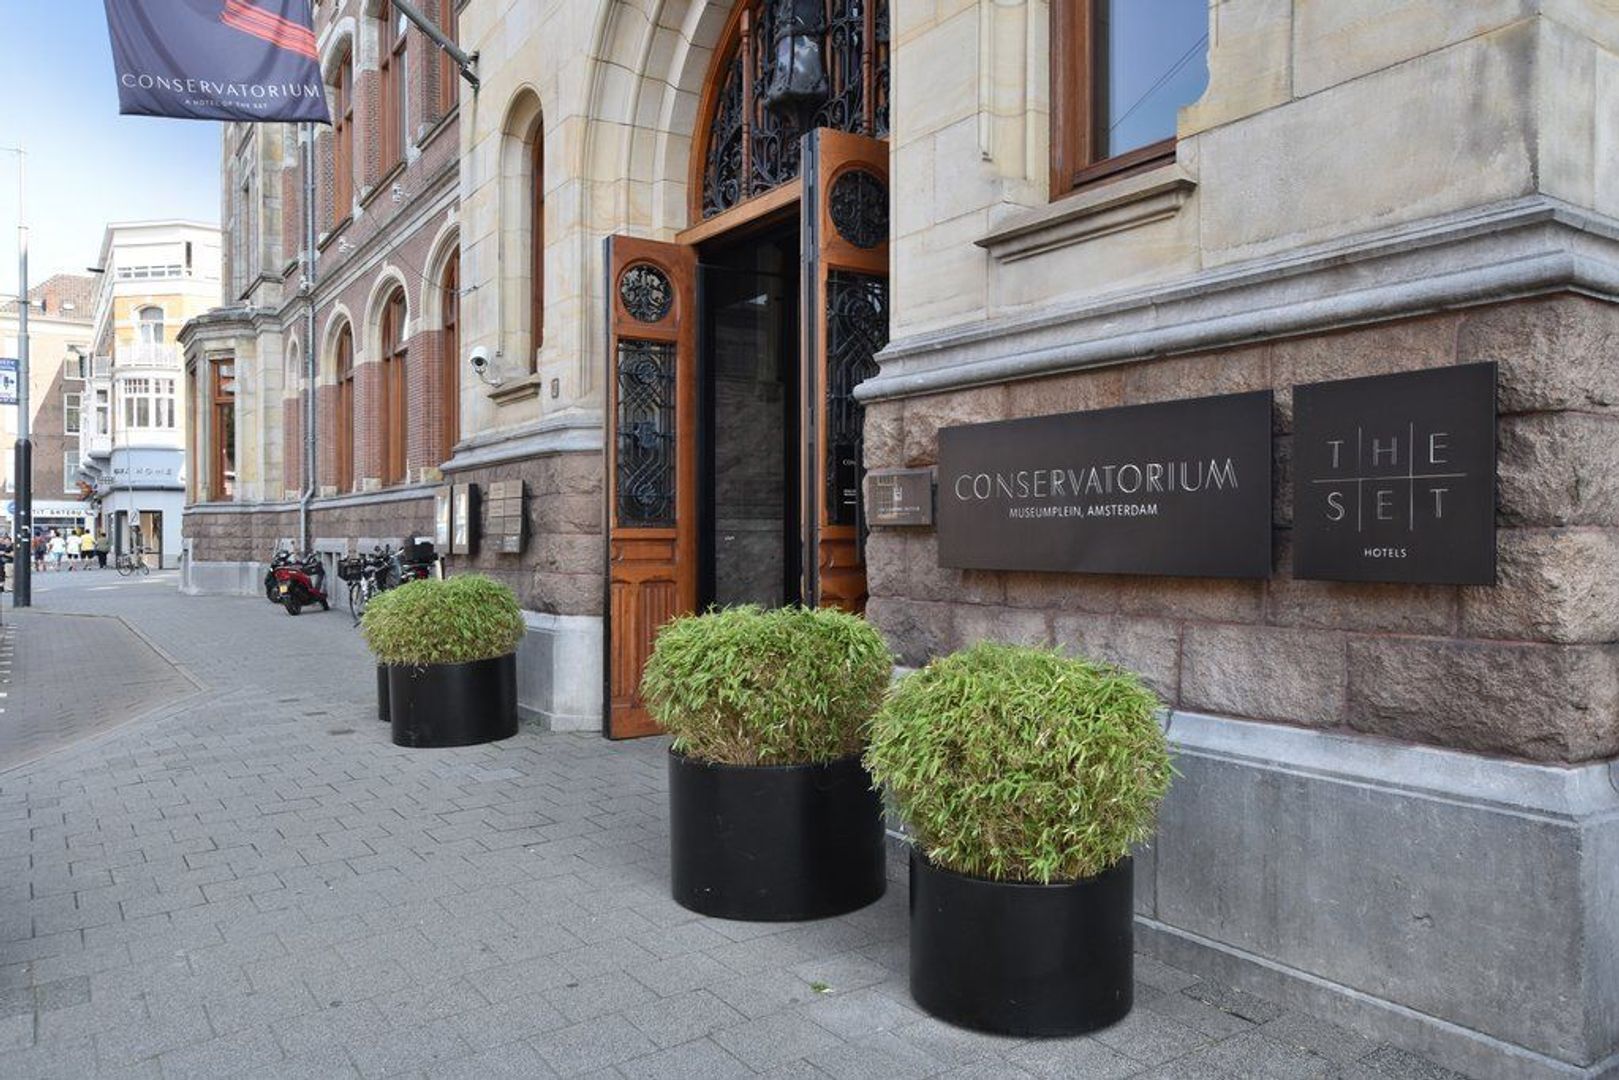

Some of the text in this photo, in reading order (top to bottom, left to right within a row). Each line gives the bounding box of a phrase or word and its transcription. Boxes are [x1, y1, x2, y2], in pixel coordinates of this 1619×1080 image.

[121, 73, 320, 98] CONSERVATORIUM
[1327, 433, 1448, 468] THE
[955, 458, 1238, 501] CONSERVATORIUM
[1009, 503, 1158, 519] MUSEUMPLEIN, AMSTERDAM
[1326, 488, 1448, 521] SET
[1364, 548, 1407, 558] HOTELS
